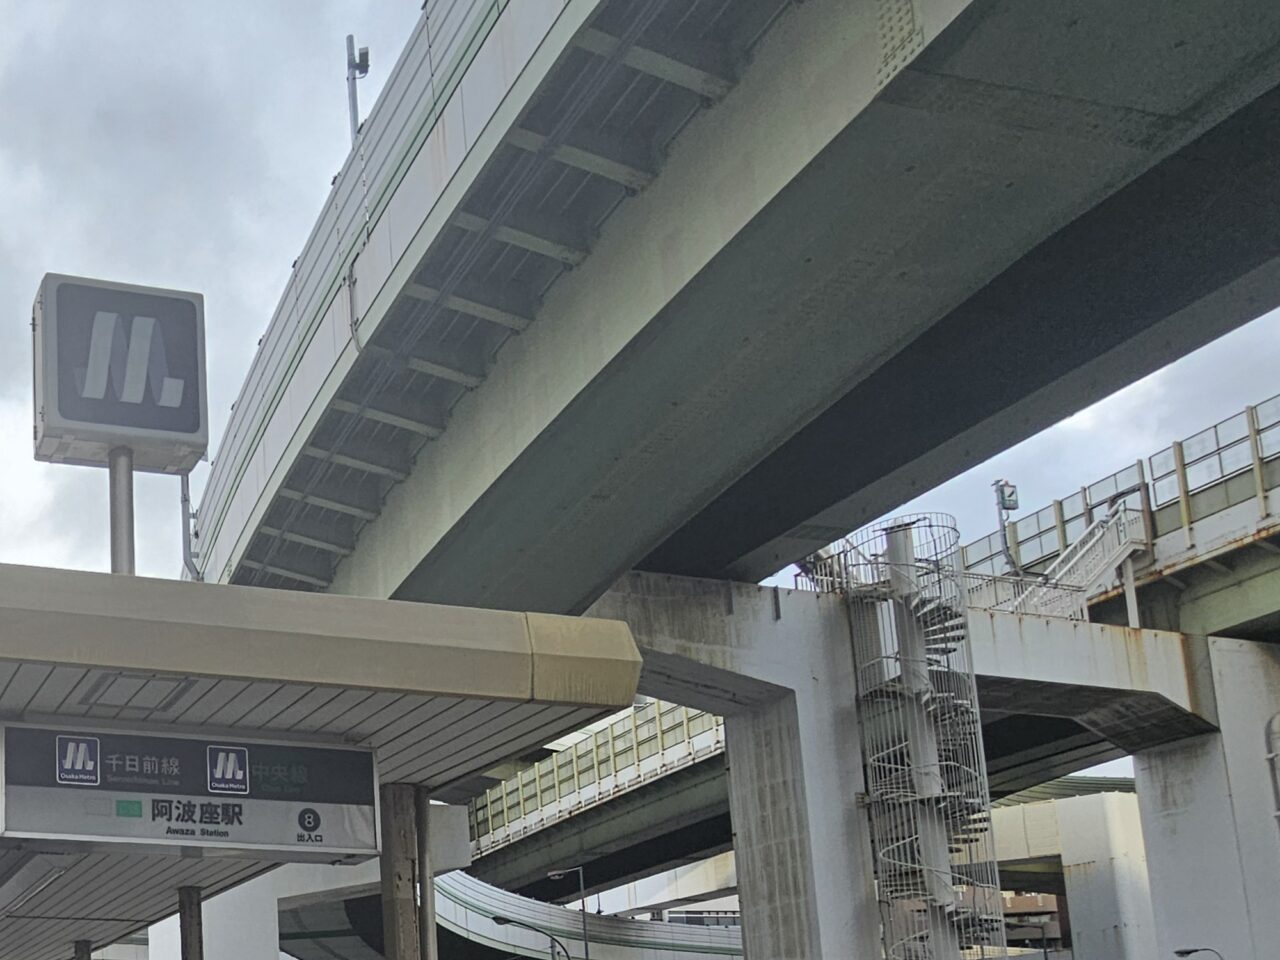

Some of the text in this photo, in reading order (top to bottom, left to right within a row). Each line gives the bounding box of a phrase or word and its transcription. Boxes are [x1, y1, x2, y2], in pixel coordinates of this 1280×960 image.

[105, 754, 181, 776] 千日前線
[151, 798, 243, 826] 阿波座駅
[166, 826, 229, 838] Awaza Station
[296, 832, 323, 843] 出入口
